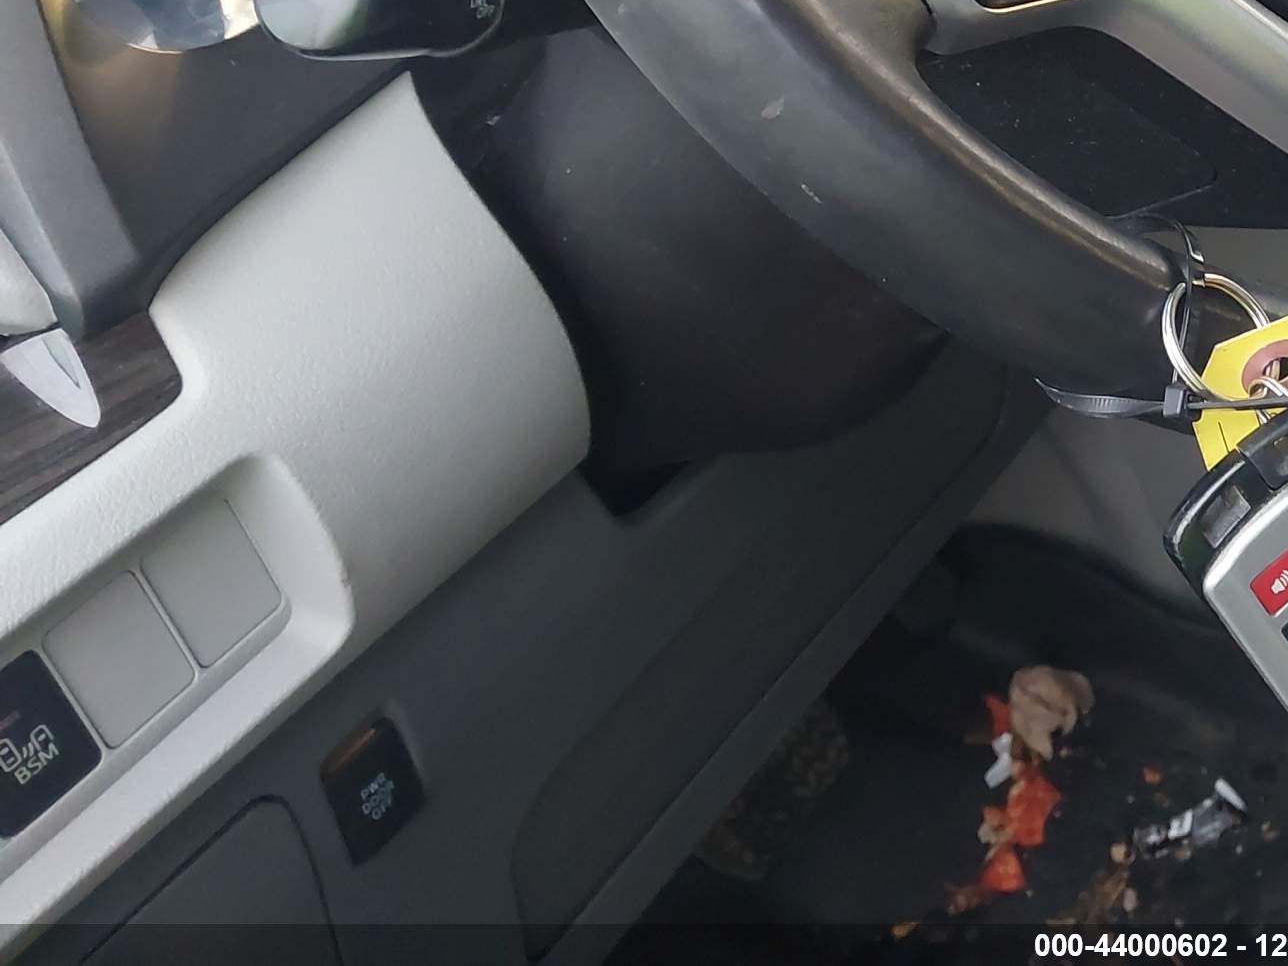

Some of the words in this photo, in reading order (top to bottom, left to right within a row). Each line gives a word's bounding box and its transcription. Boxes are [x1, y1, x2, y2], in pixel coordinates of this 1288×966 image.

[476, 4, 495, 19] OFF
[14, 742, 60, 785] BSM
[360, 772, 386, 802] PWR
[361, 780, 395, 815] DOOR
[371, 793, 393, 821] OFF
